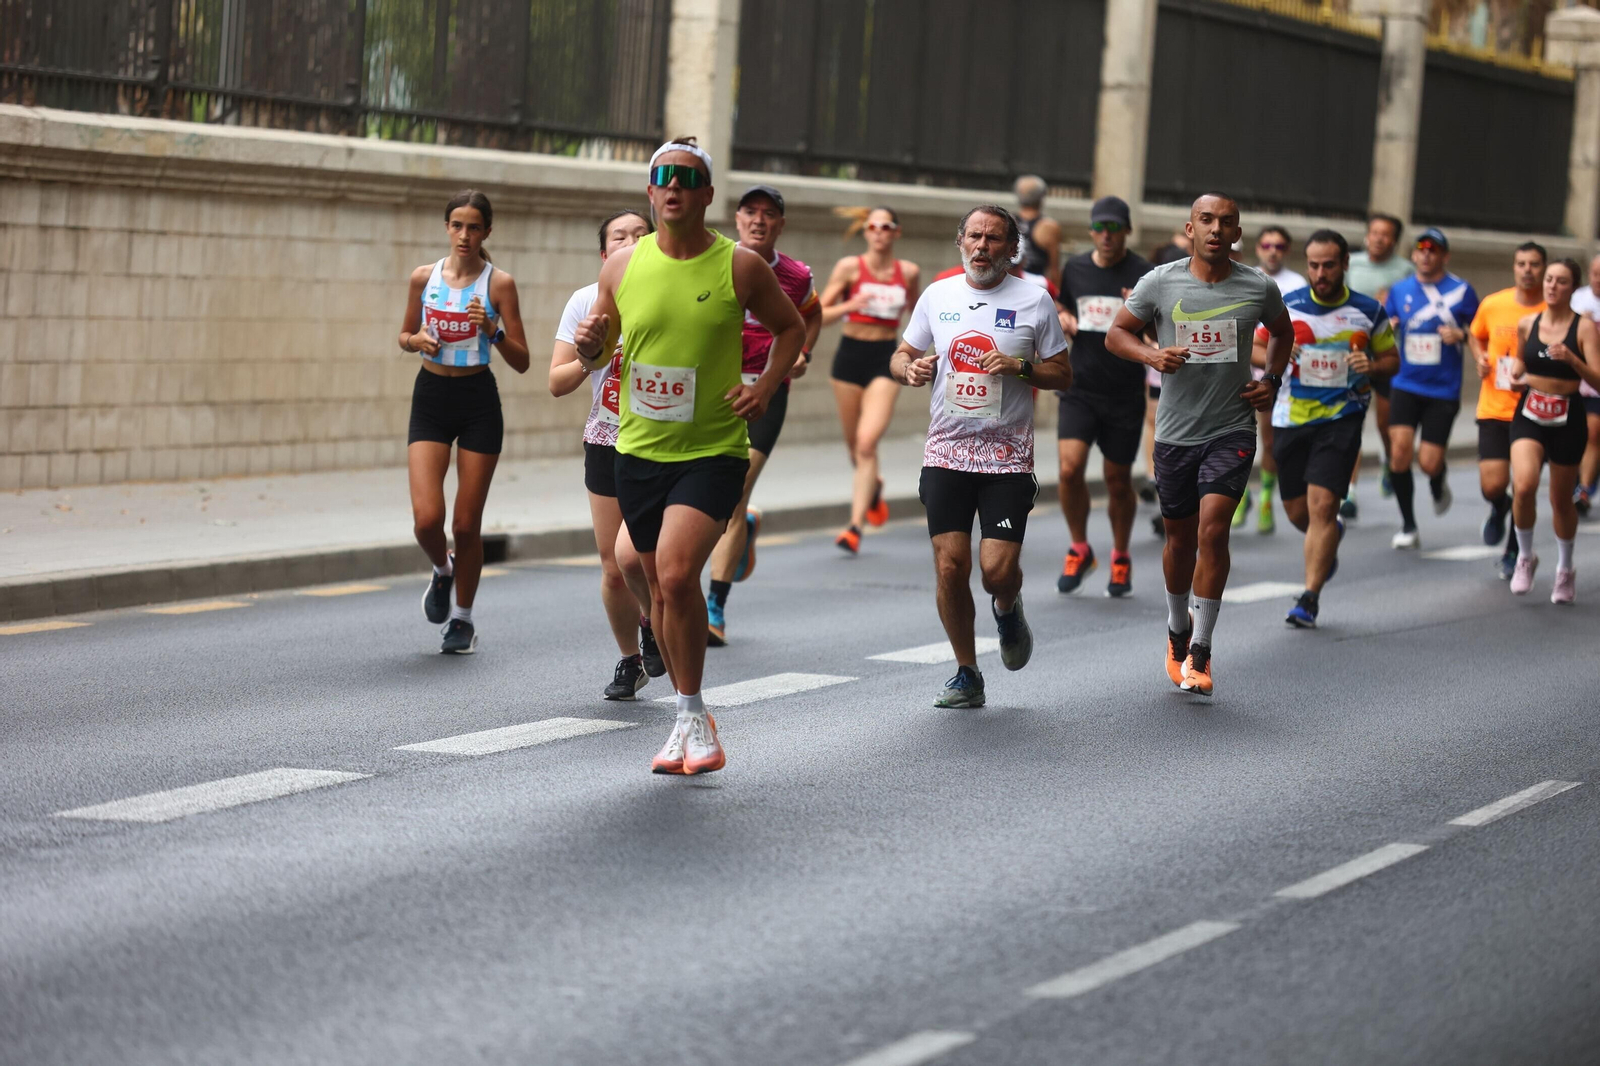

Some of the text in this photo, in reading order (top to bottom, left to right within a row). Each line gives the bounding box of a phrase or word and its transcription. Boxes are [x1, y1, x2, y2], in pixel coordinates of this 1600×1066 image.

[429, 317, 471, 332] 2088
[995, 319, 1012, 327] AXA
[1192, 331, 1222, 343] 151
[956, 342, 985, 357] PONL
[636, 378, 685, 396] 1216
[956, 383, 988, 397] 703
